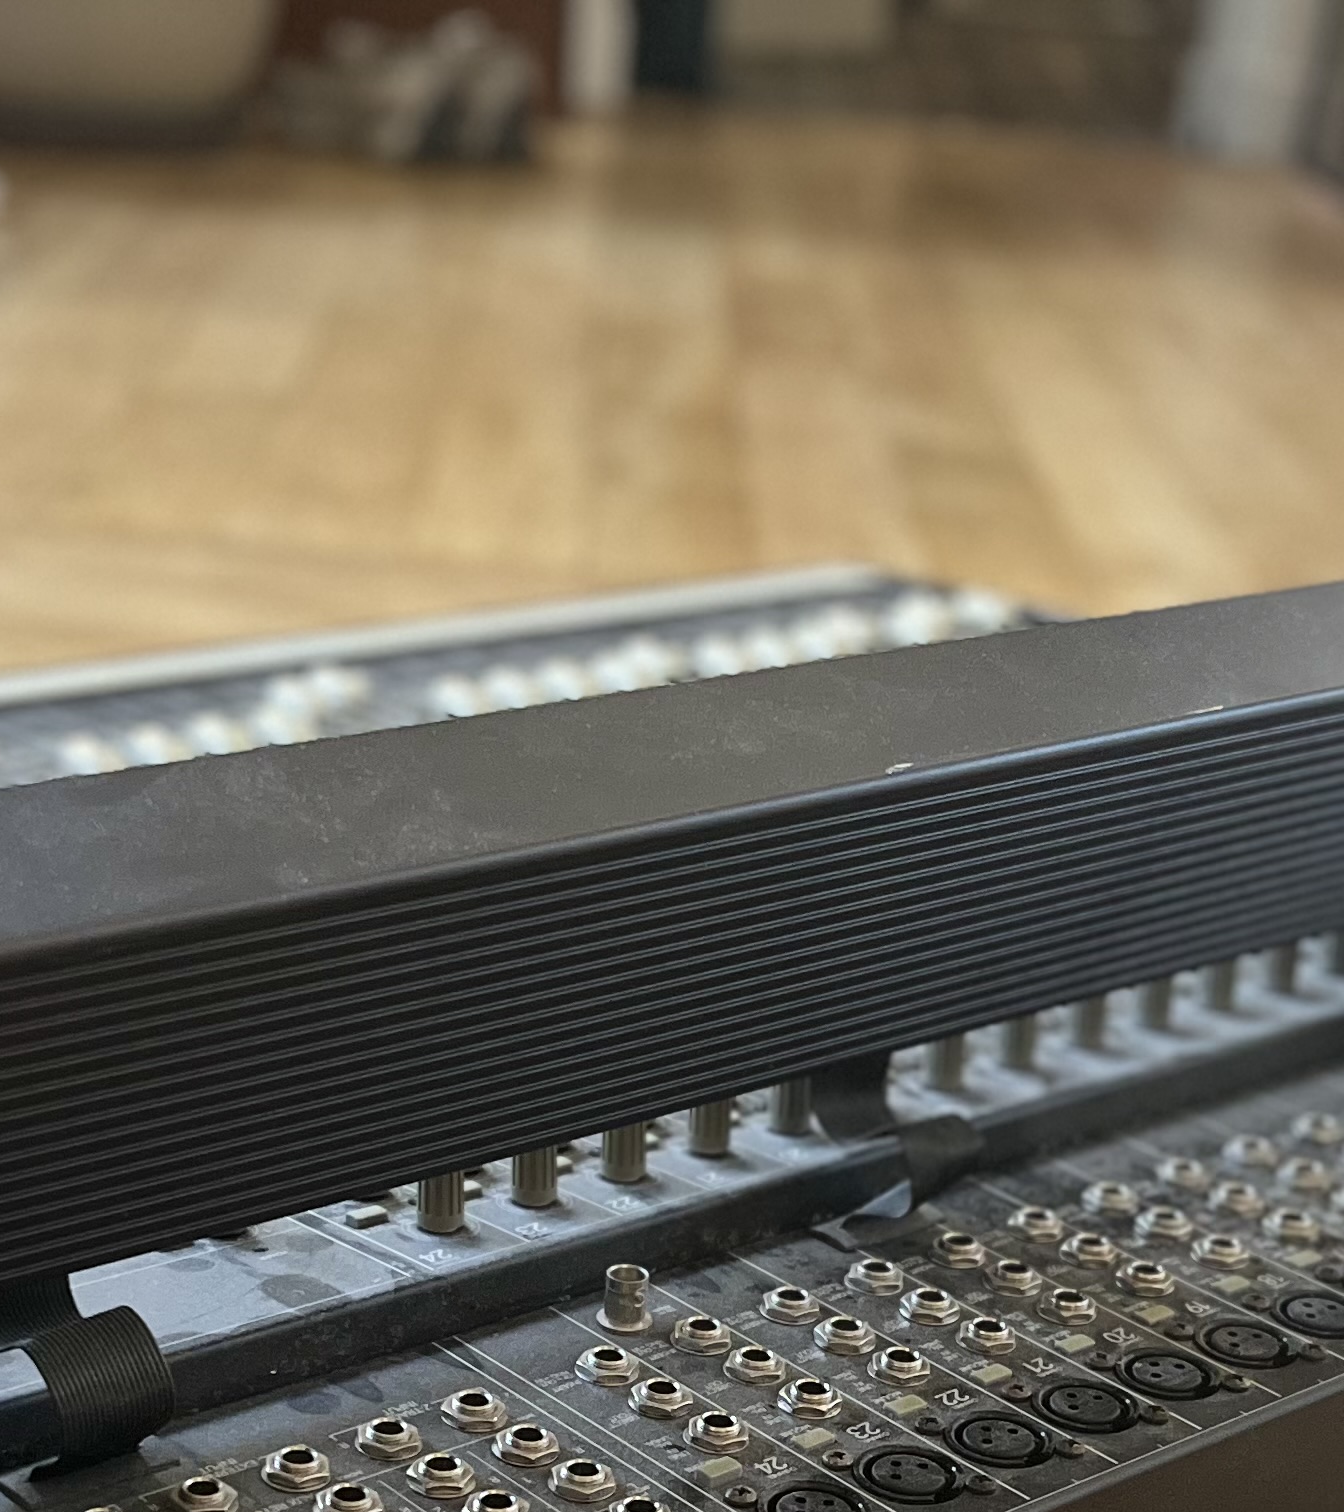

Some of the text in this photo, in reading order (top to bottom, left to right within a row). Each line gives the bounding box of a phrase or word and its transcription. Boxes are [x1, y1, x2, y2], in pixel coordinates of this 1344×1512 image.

[515, 1222, 548, 1239] 23
[419, 1248, 453, 1264] 24
[1022, 1357, 1054, 1373] 21
[934, 1388, 970, 1406] 22
[846, 1421, 881, 1440] 23
[754, 1456, 788, 1476] 24
